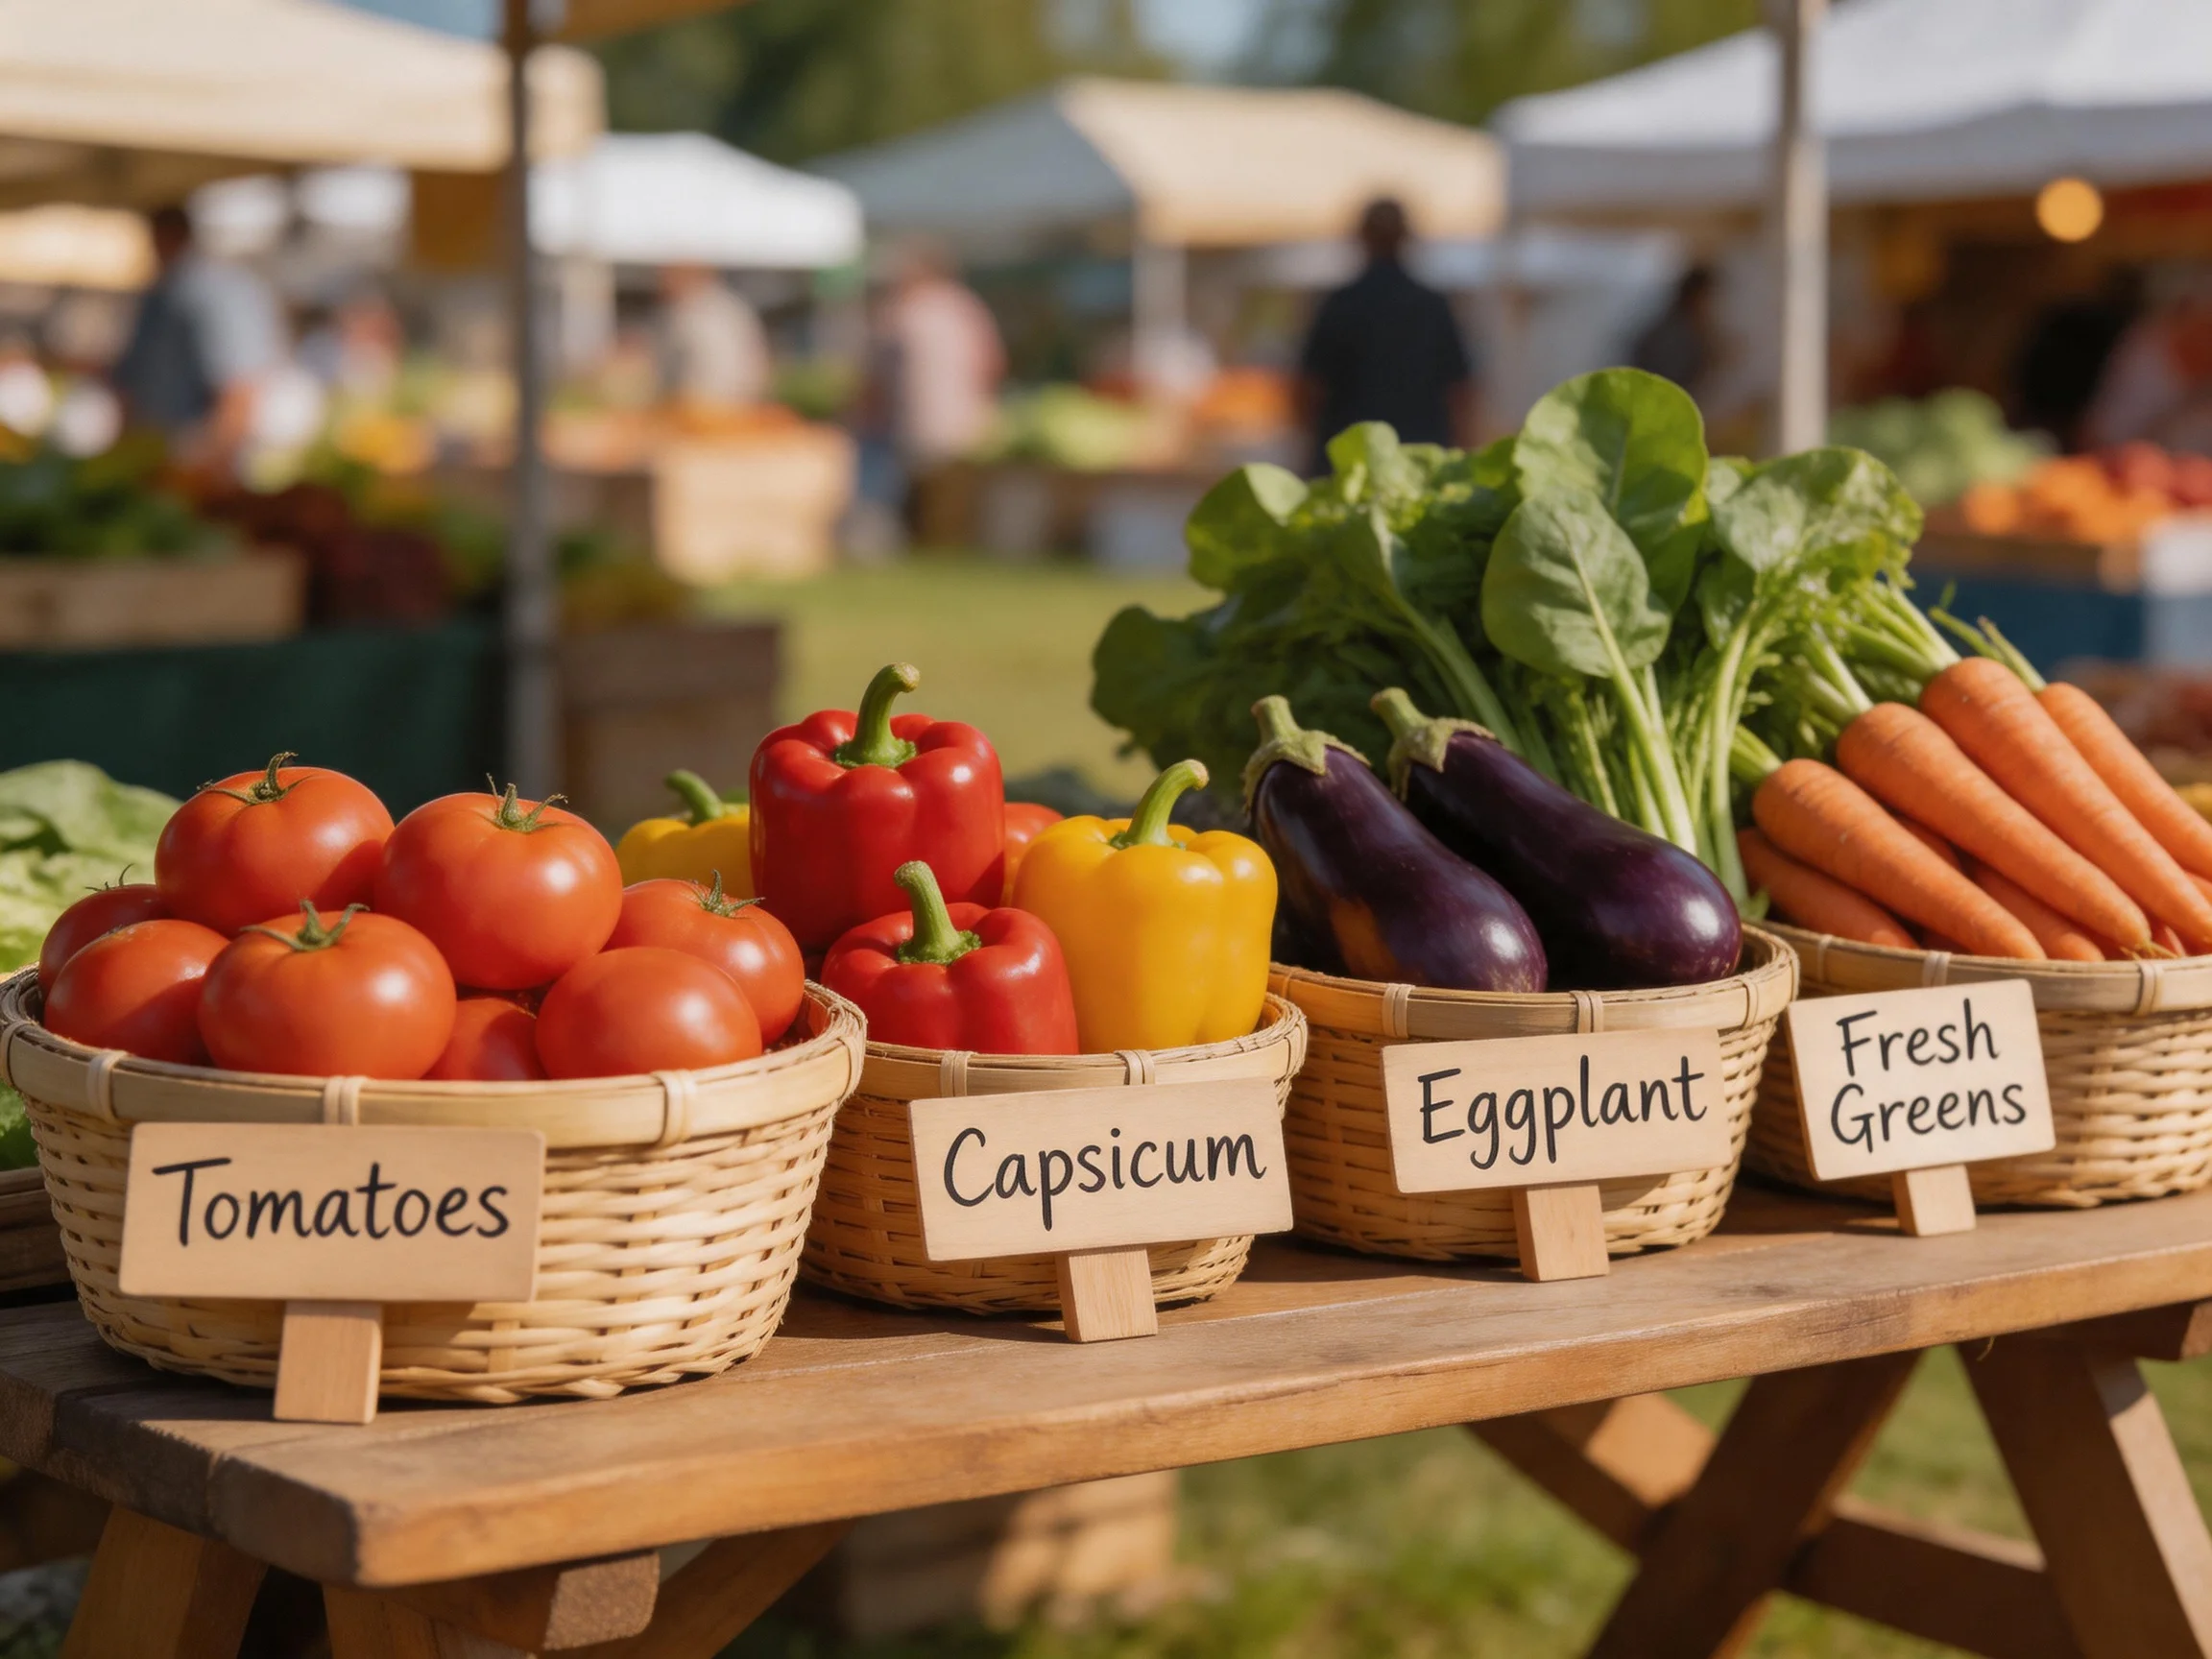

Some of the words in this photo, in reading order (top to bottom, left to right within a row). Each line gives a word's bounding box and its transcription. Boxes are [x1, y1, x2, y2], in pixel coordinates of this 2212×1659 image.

[1835, 998, 1998, 1077] Fresh
[1417, 1054, 1707, 1174] Eggplant
[1830, 1083, 2027, 1154] Greens
[151, 1157, 510, 1246] Tomatoes
[943, 1127, 1267, 1233] Capsicum
